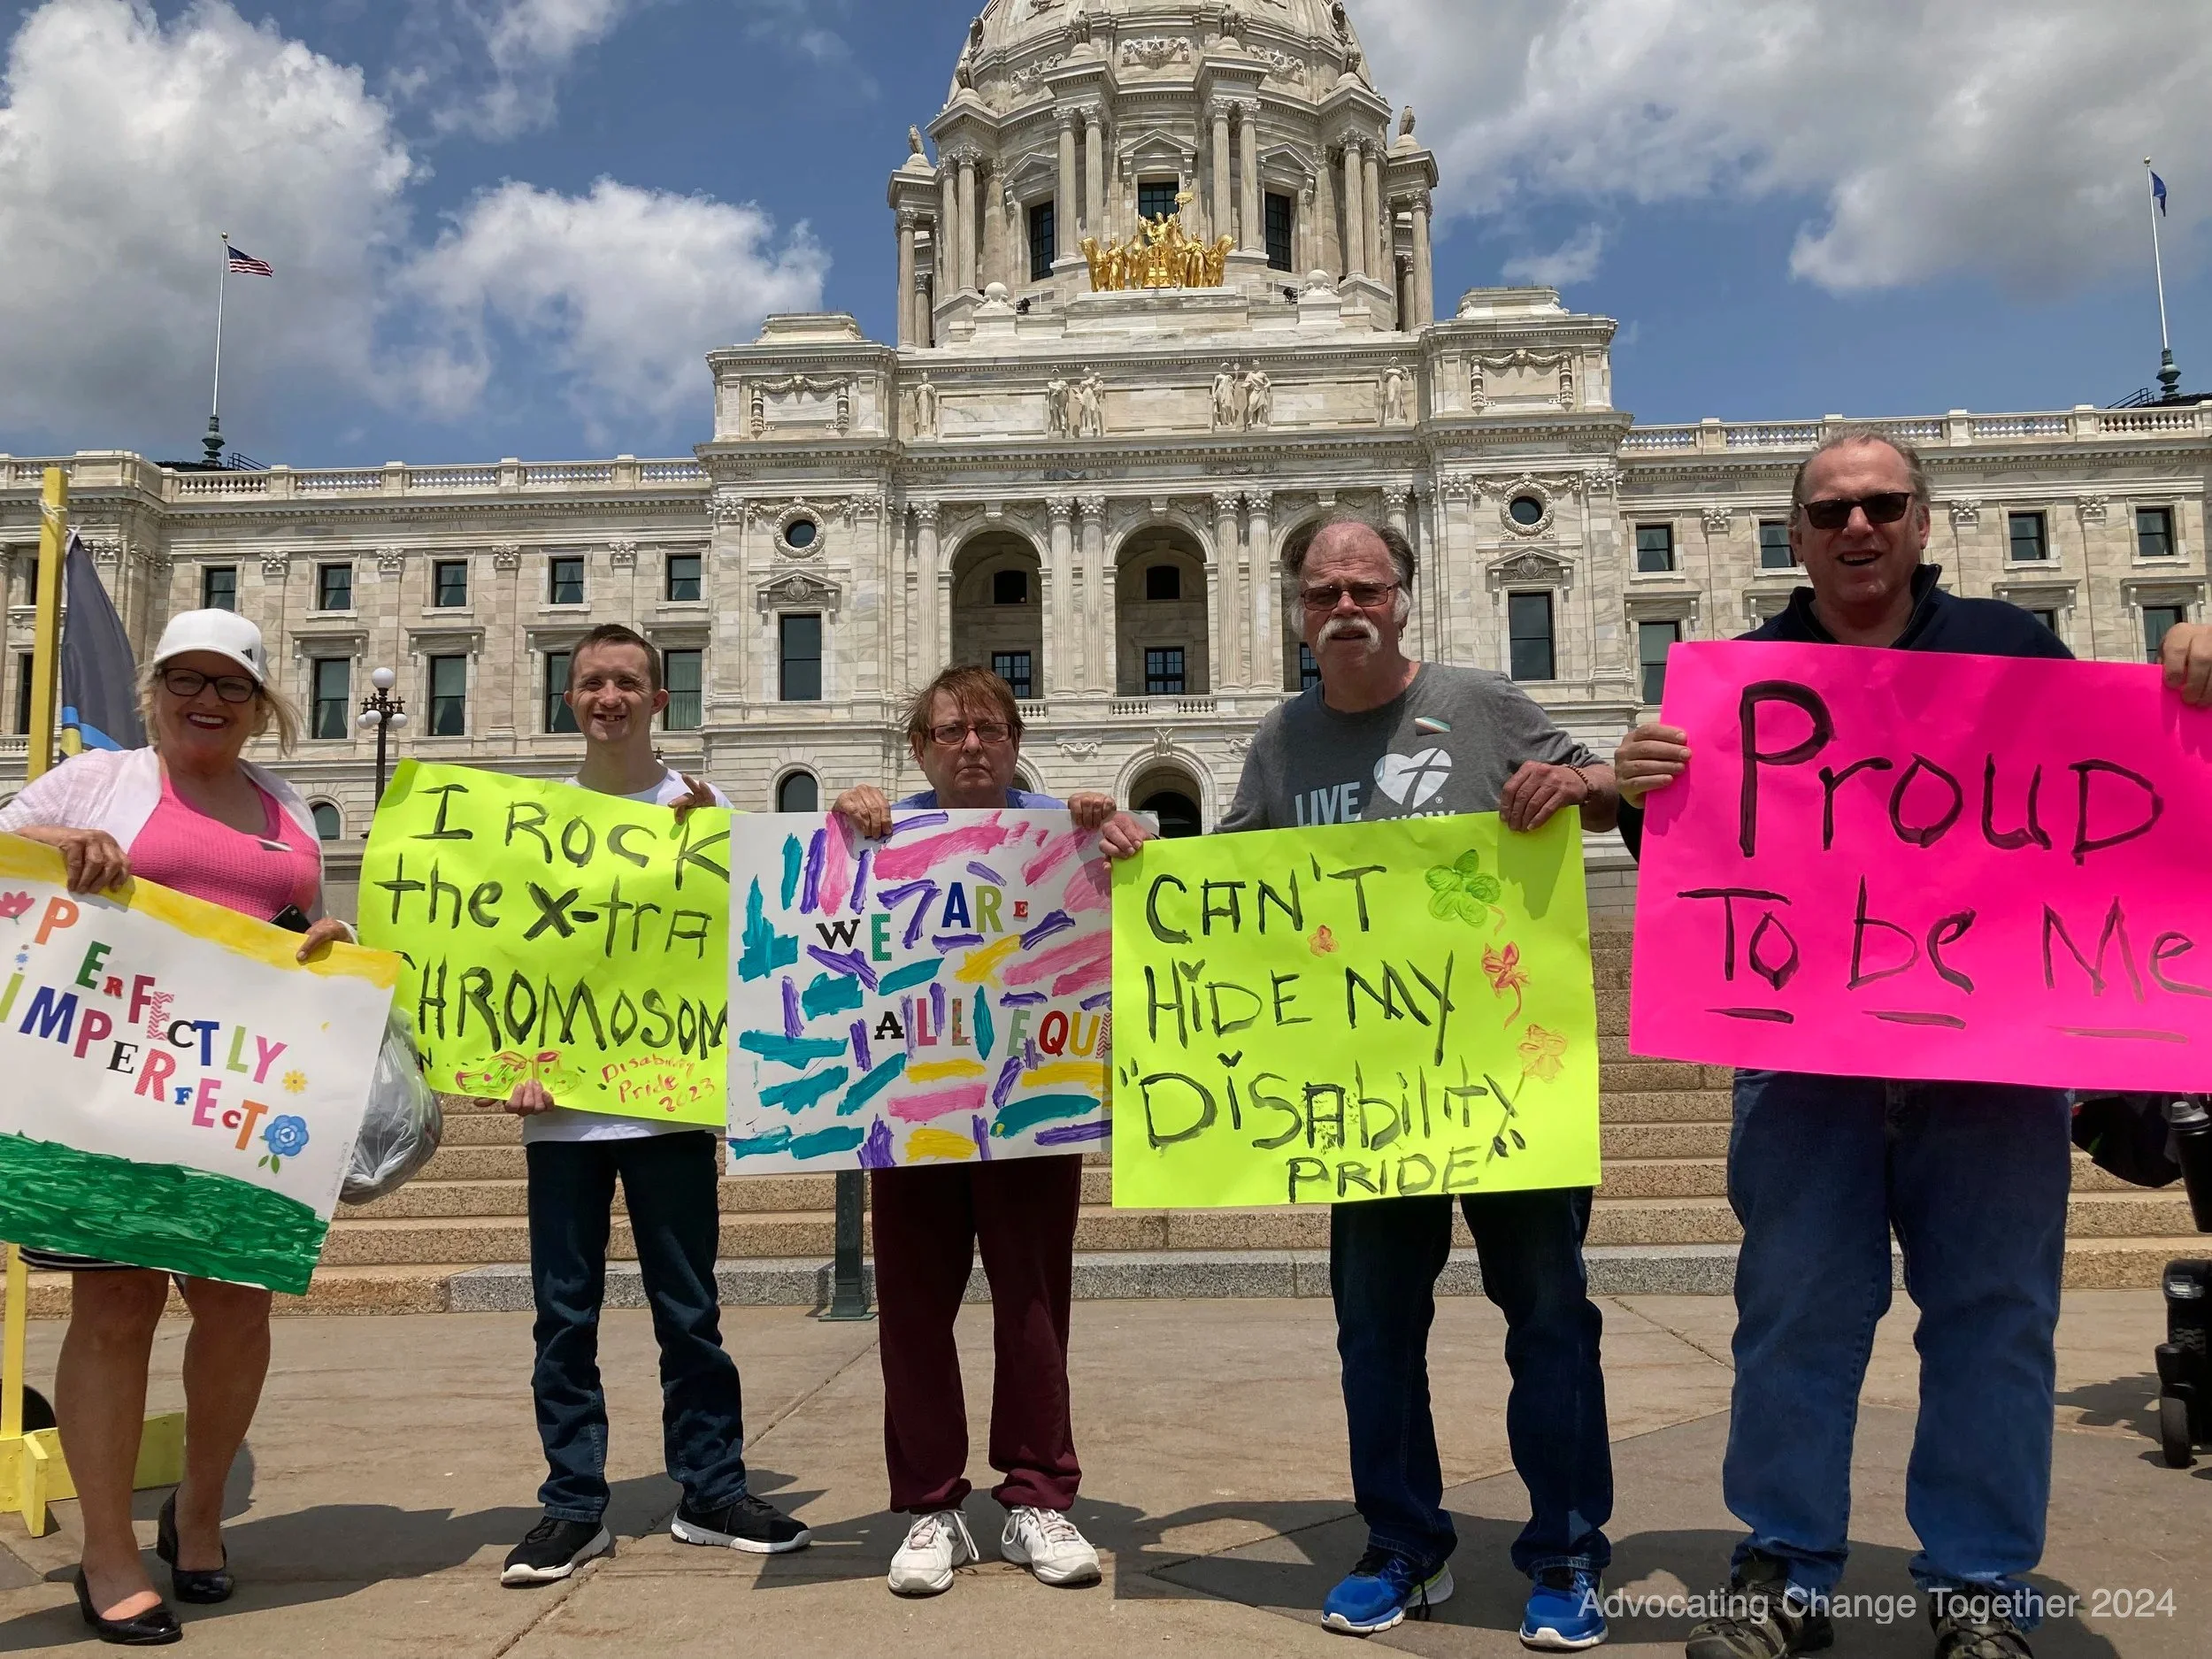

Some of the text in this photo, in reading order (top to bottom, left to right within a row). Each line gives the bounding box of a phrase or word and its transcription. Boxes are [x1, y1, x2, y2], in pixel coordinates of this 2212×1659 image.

[409, 783, 731, 890] I ROCK
[1294, 781, 1361, 827] LIVE
[373, 852, 503, 929] the
[816, 881, 1028, 962] WE ARE
[1146, 852, 1386, 944] CAN'T
[1847, 874, 1978, 995] be
[2042, 895, 2212, 1003] Me
[34, 896, 288, 1084] PERFECTLY
[873, 997, 972, 1047] ALL
[0, 972, 270, 1150] IMPERFECT
[618, 1073, 680, 1104] Pride
[658, 1077, 716, 1112] 2023
